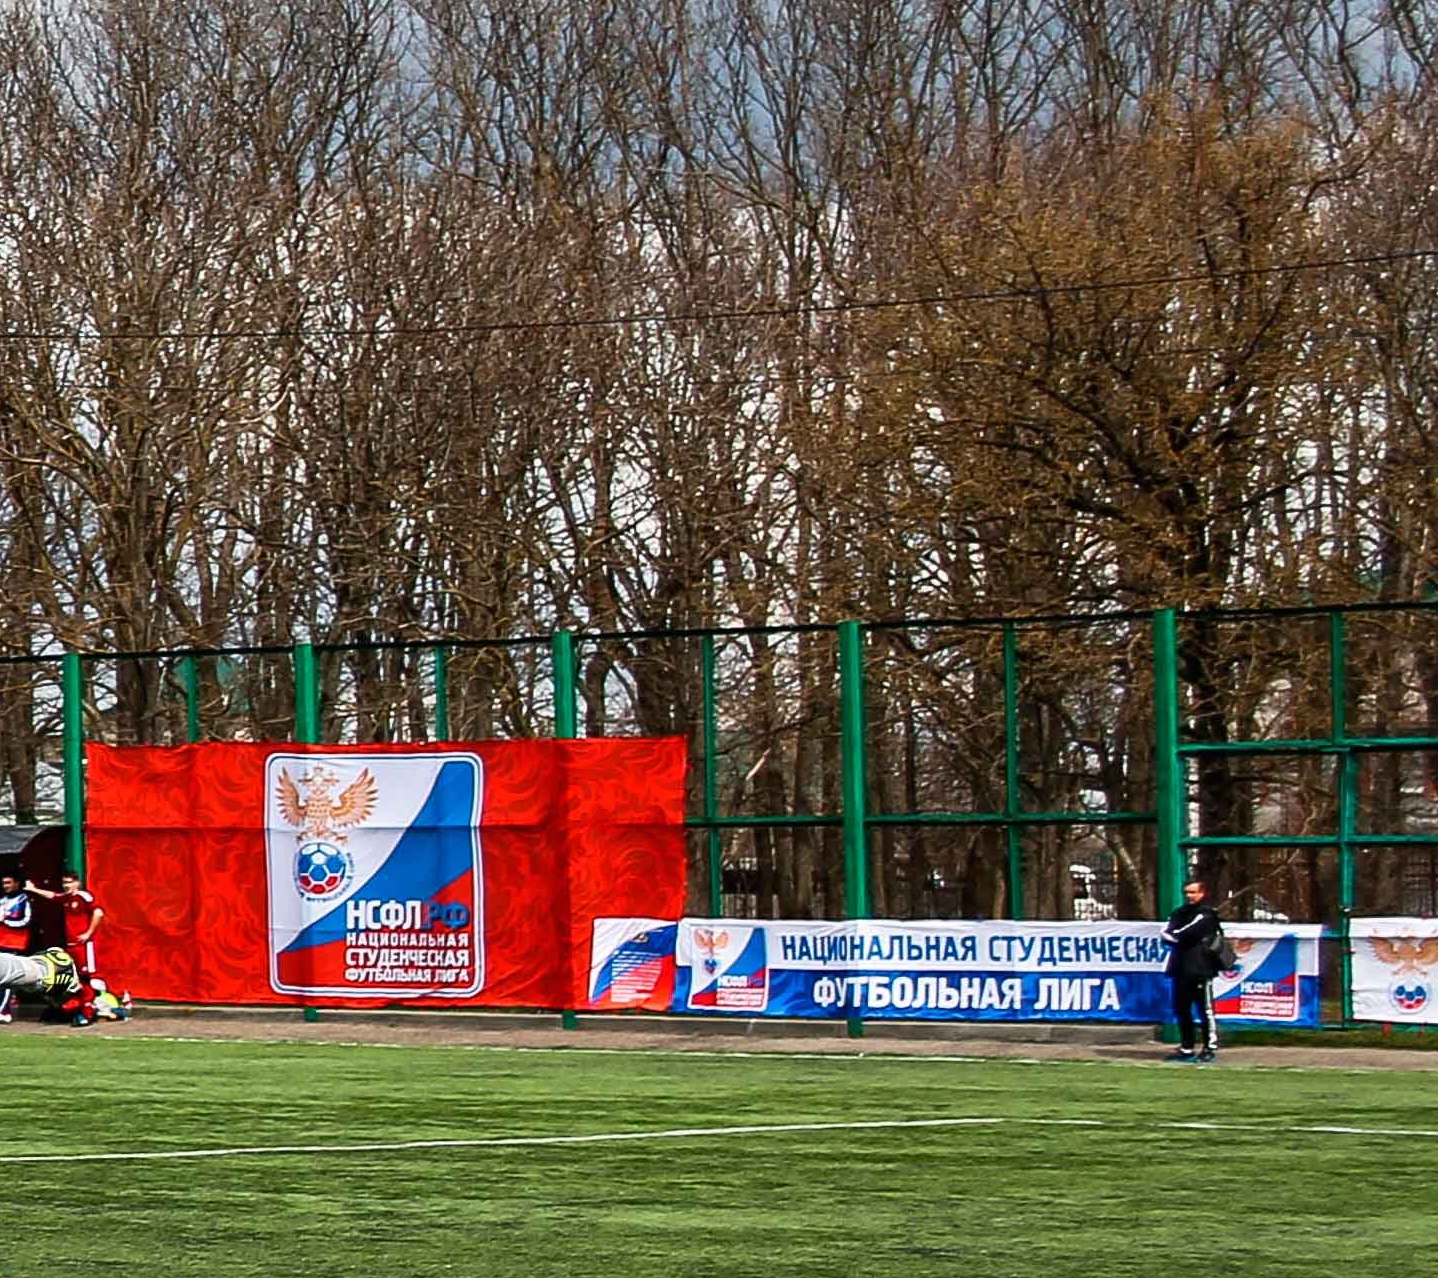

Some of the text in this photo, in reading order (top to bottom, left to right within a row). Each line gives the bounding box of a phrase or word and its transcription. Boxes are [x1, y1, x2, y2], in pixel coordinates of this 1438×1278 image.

[346, 932, 469, 949] НАЦИОНАЛЬНАЯ
[781, 934, 977, 966] НАЦИОНАЛЬНАЯ
[345, 948, 469, 968] СТУДЕНЧЕСКАЯ
[345, 968, 469, 983] ФУТБОЛЬНАЯ ЛИГА
[813, 976, 1121, 1010] ФУТБОЛЬНАЯ ЛИГА
